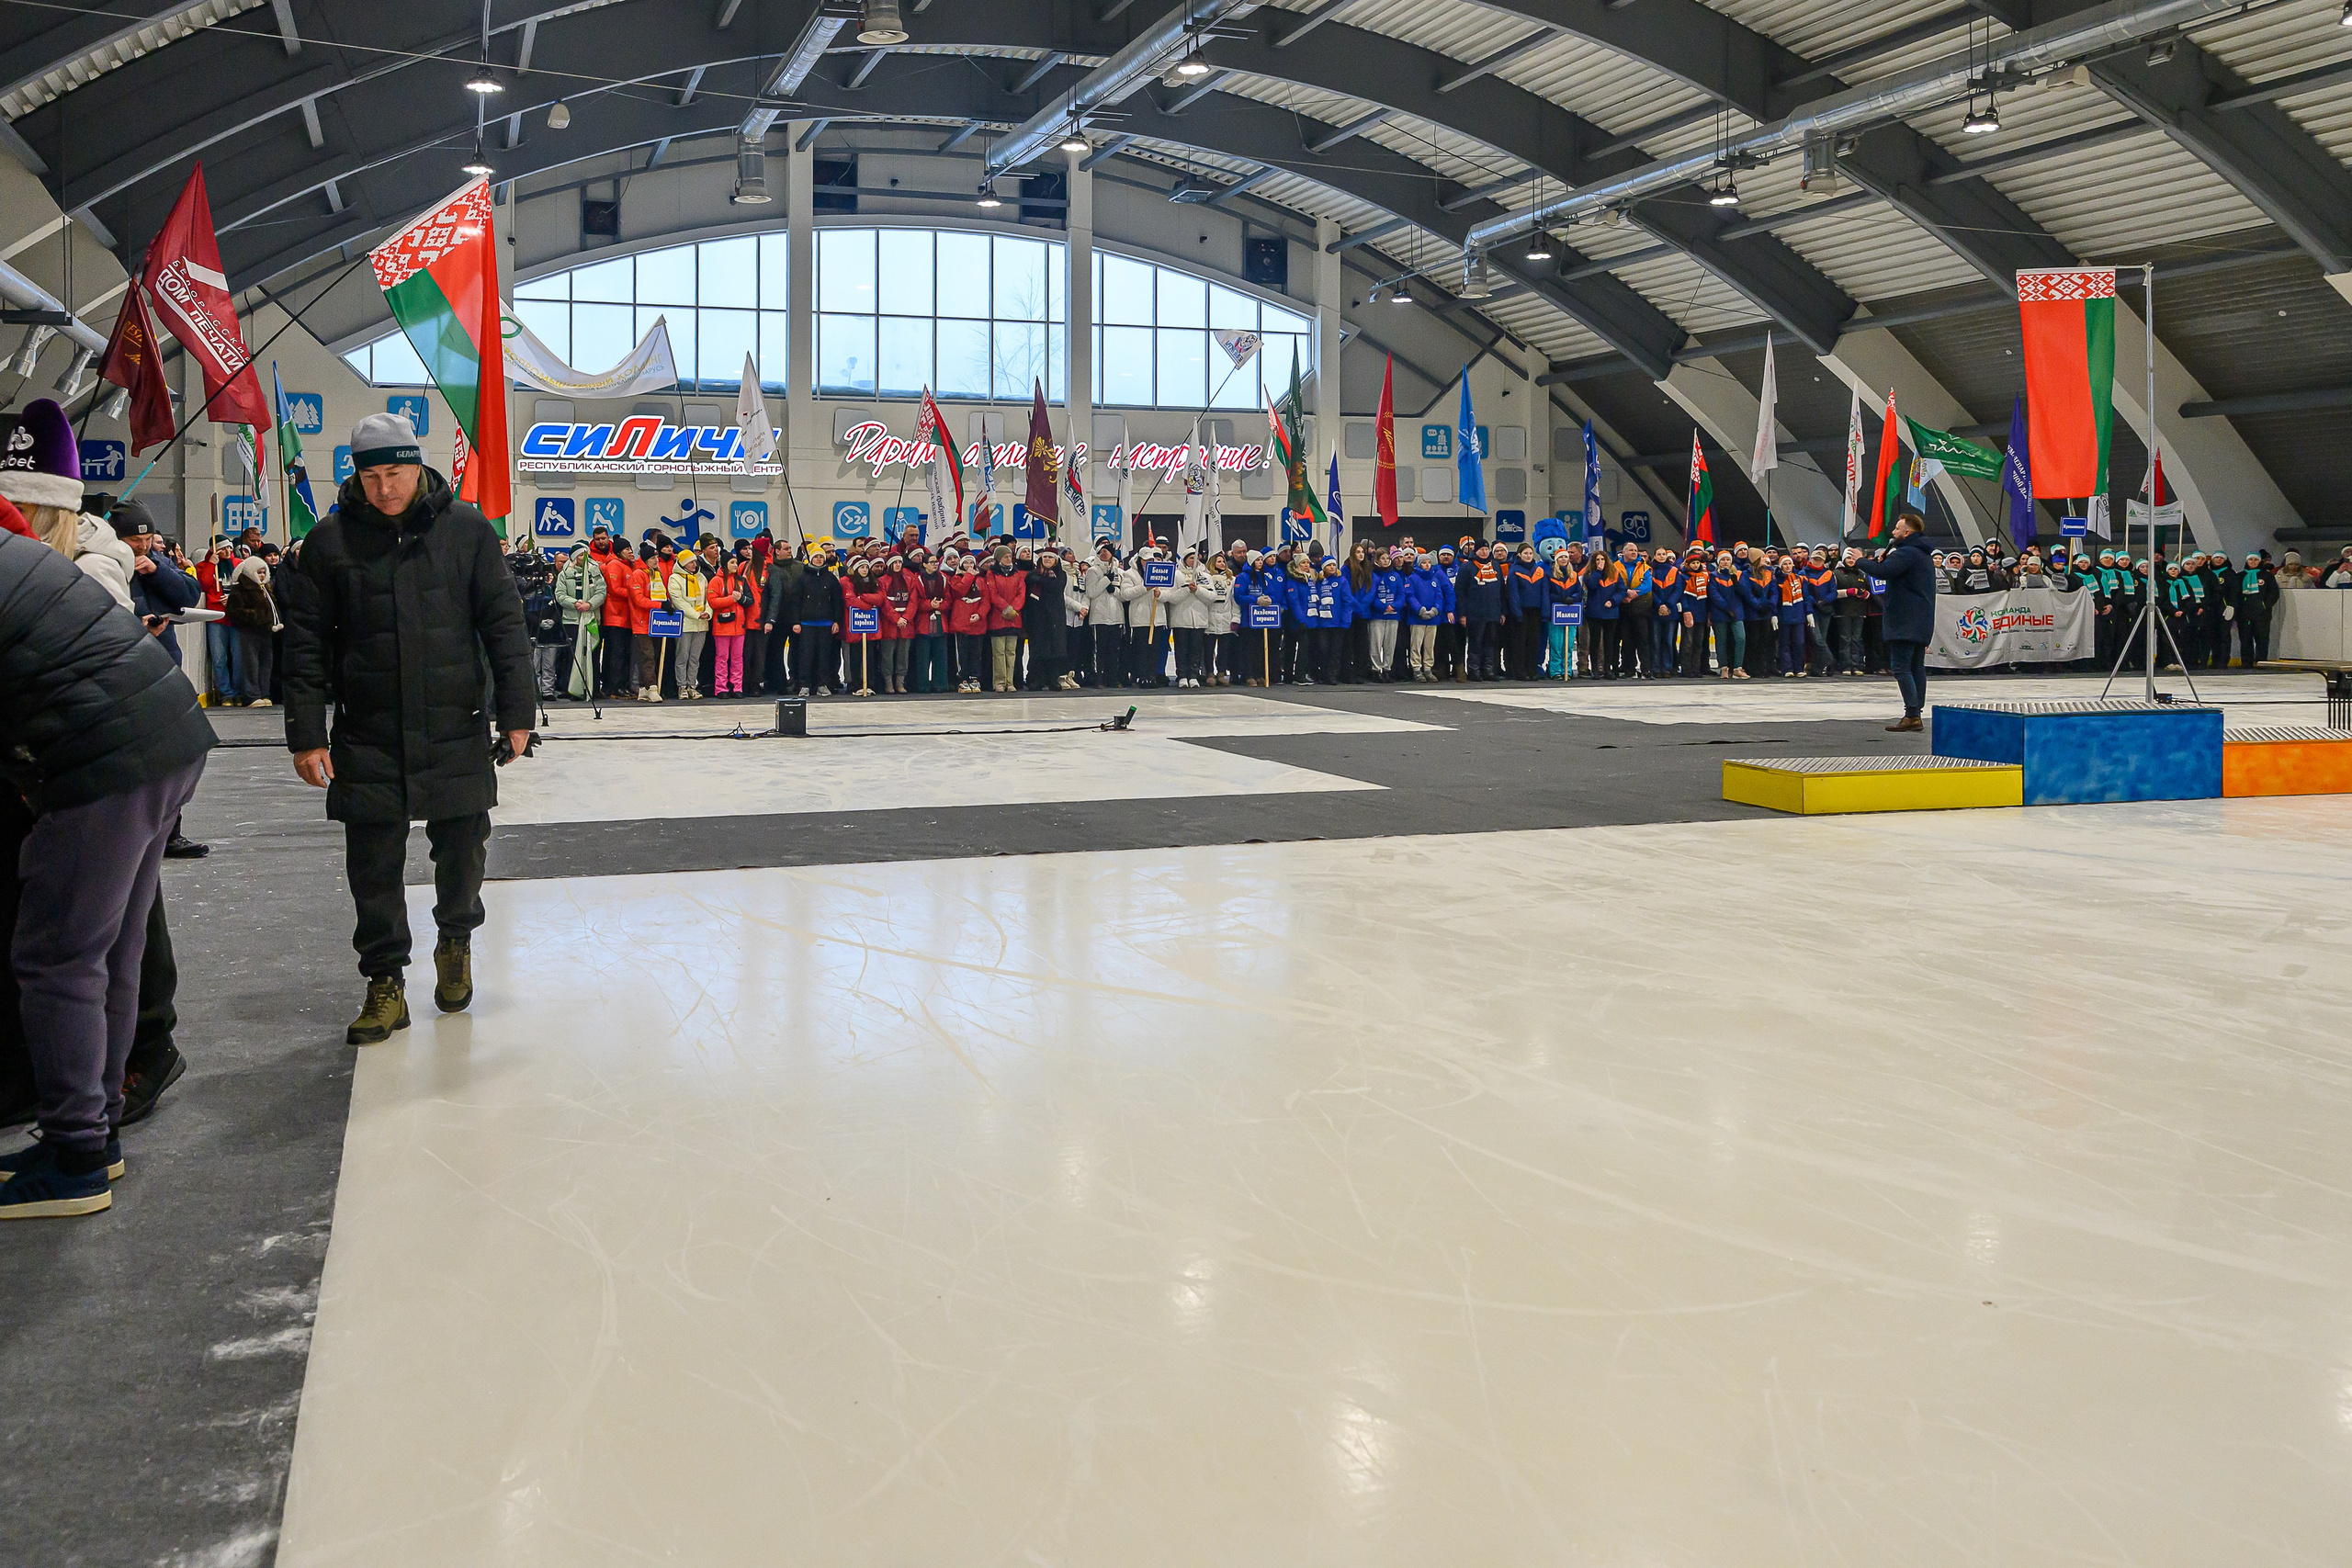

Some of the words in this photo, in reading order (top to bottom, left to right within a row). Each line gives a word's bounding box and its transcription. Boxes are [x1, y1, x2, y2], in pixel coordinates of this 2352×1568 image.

[156, 268, 190, 305] ДОМ
[189, 309, 245, 372] ПЕЧАТИ
[519, 461, 645, 472] РЕСПУБЛИКАНСКИЙ
[647, 463, 742, 473] ГОРНОЛЫЖНЫЙ
[752, 465, 783, 474] ЕНТР
[936, 495, 946, 528] фабрика
[854, 514, 868, 525] 24
[1151, 566, 1169, 574] Белые
[1992, 615, 2054, 631] ЕДИНЫЕ
